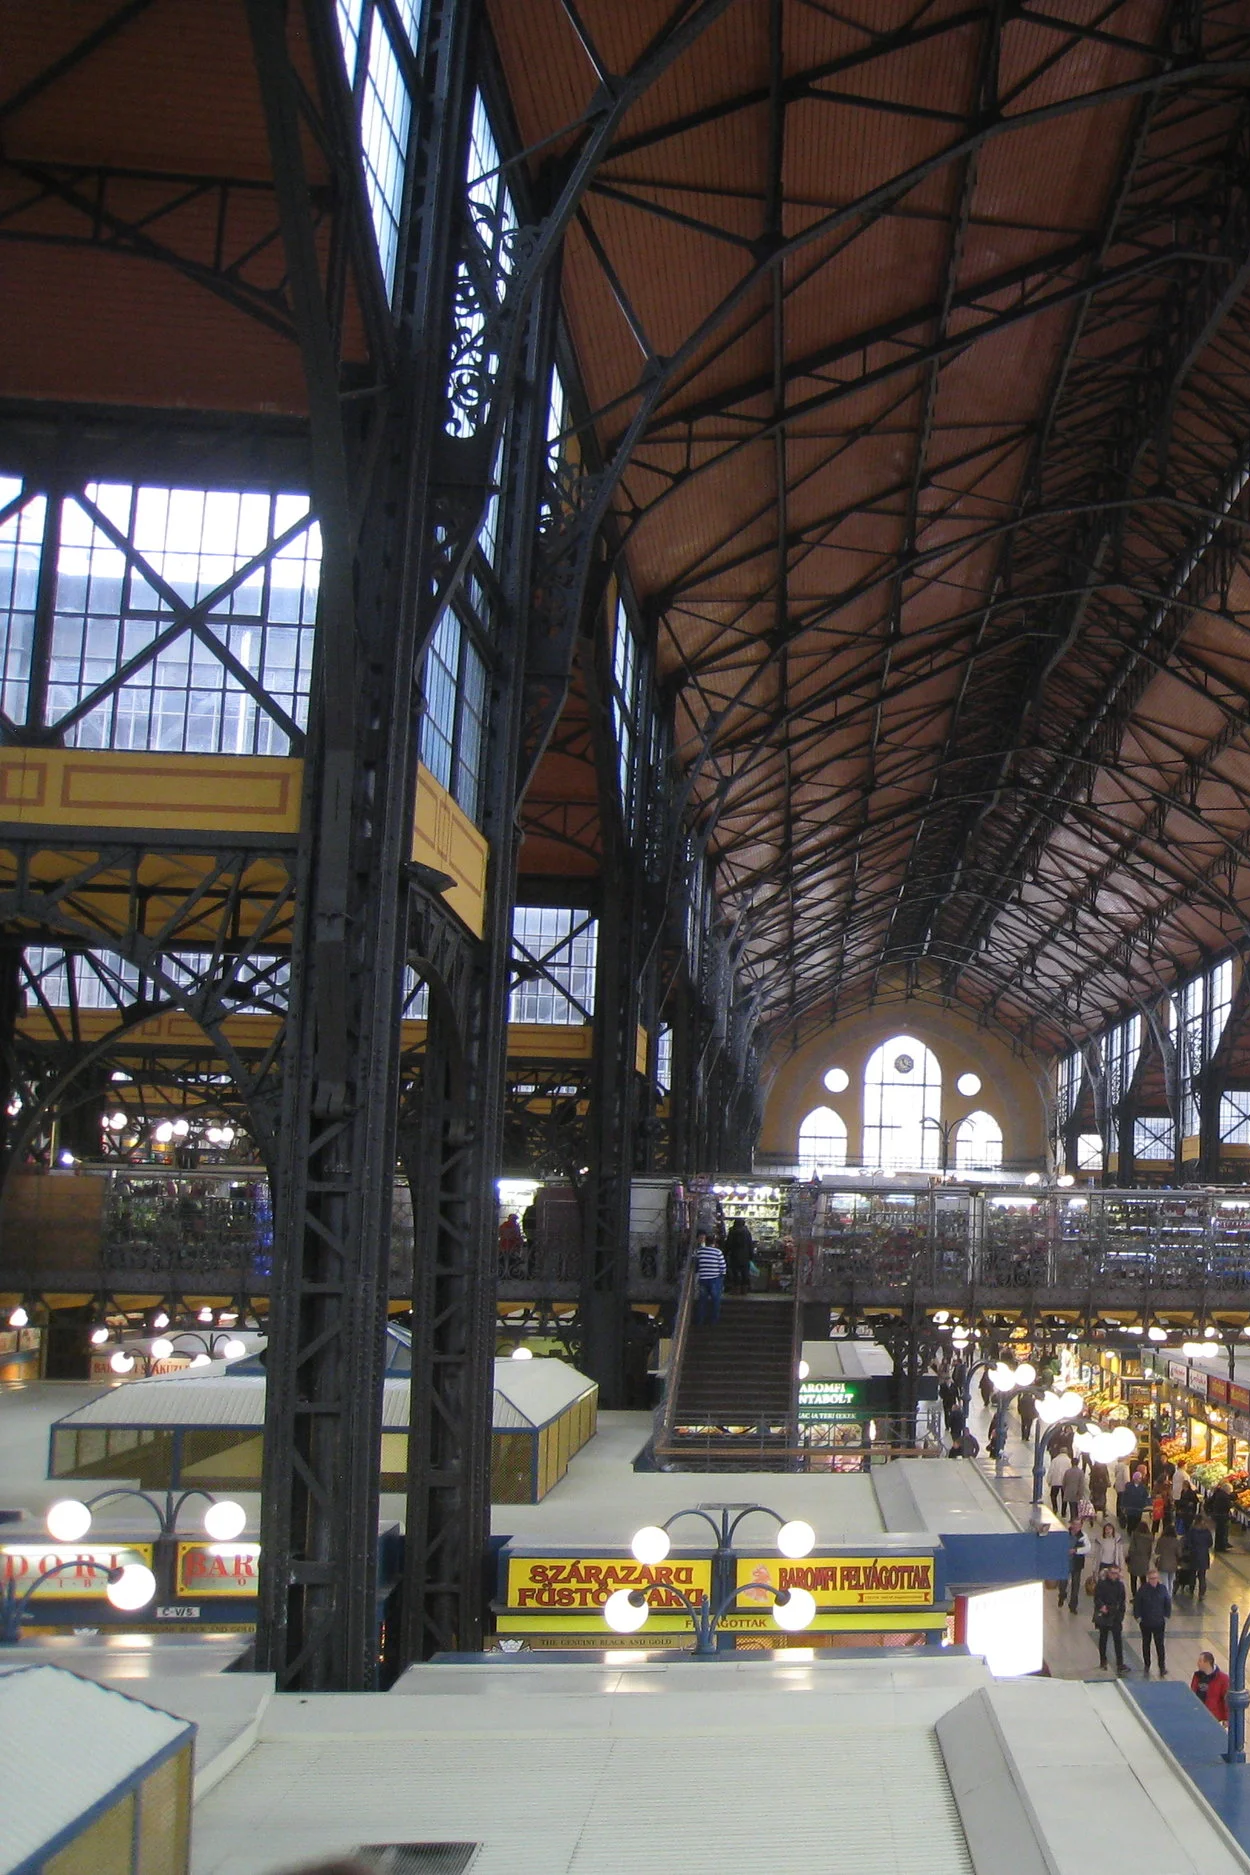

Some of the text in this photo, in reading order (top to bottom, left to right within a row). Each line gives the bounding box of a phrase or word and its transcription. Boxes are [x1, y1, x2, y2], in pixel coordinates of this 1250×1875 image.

[799, 1383, 846, 1393] AROMFI
[778, 1558, 932, 1591] BAROMFI FELVÁGOTTAK
